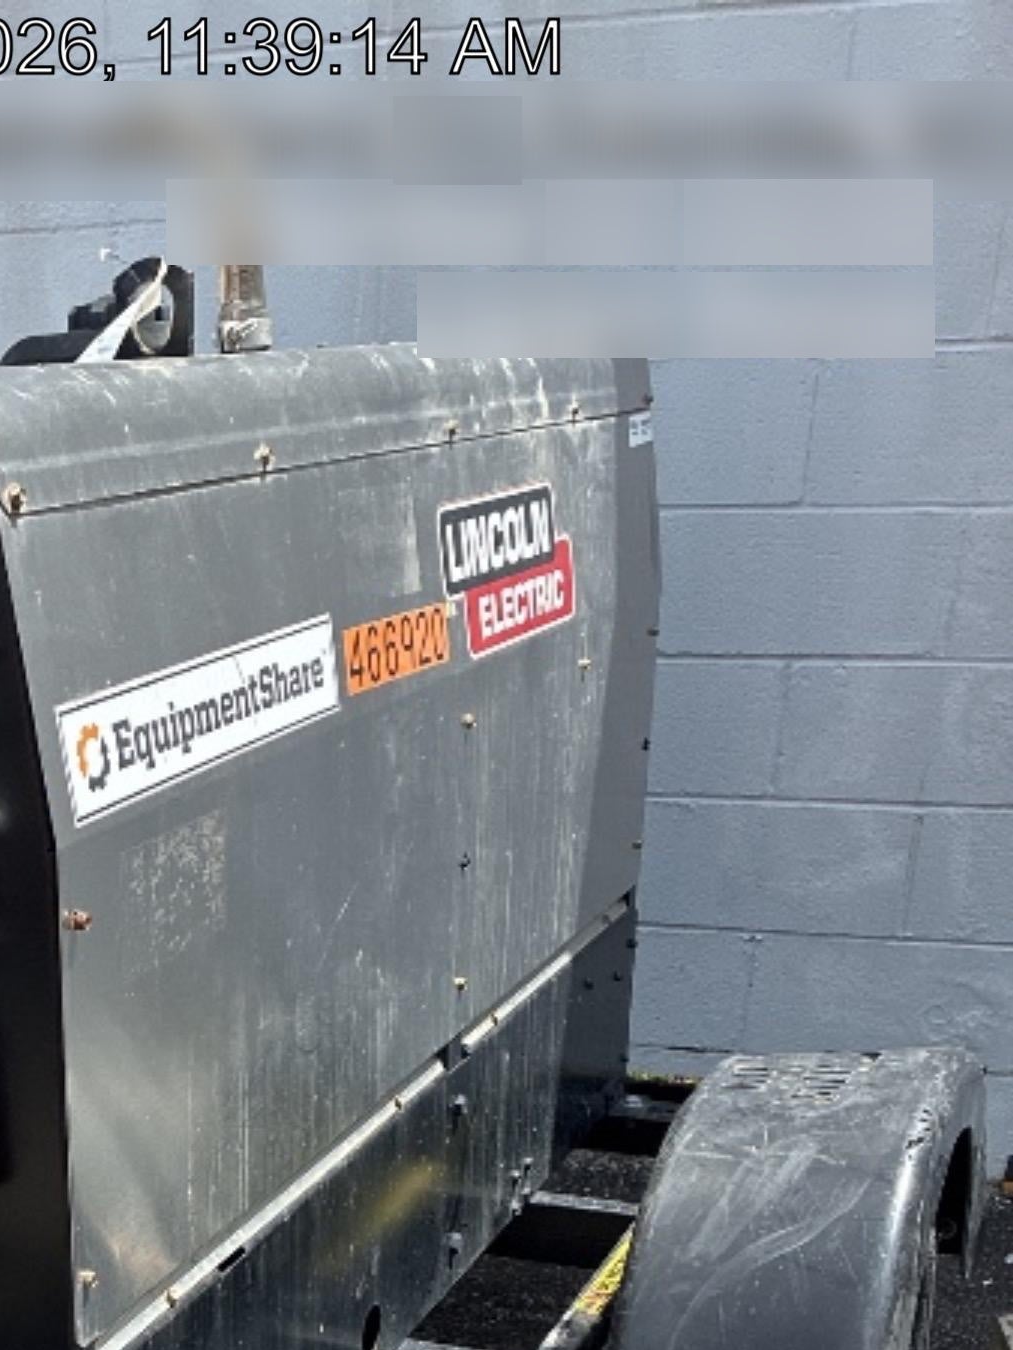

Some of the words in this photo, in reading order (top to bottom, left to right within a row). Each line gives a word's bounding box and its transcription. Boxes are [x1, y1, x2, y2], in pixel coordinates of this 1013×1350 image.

[444, 500, 550, 583] LINCOLN
[478, 572, 565, 638] ELECTRIC
[349, 608, 448, 687] 466920
[112, 655, 326, 770] EquipmentShare
